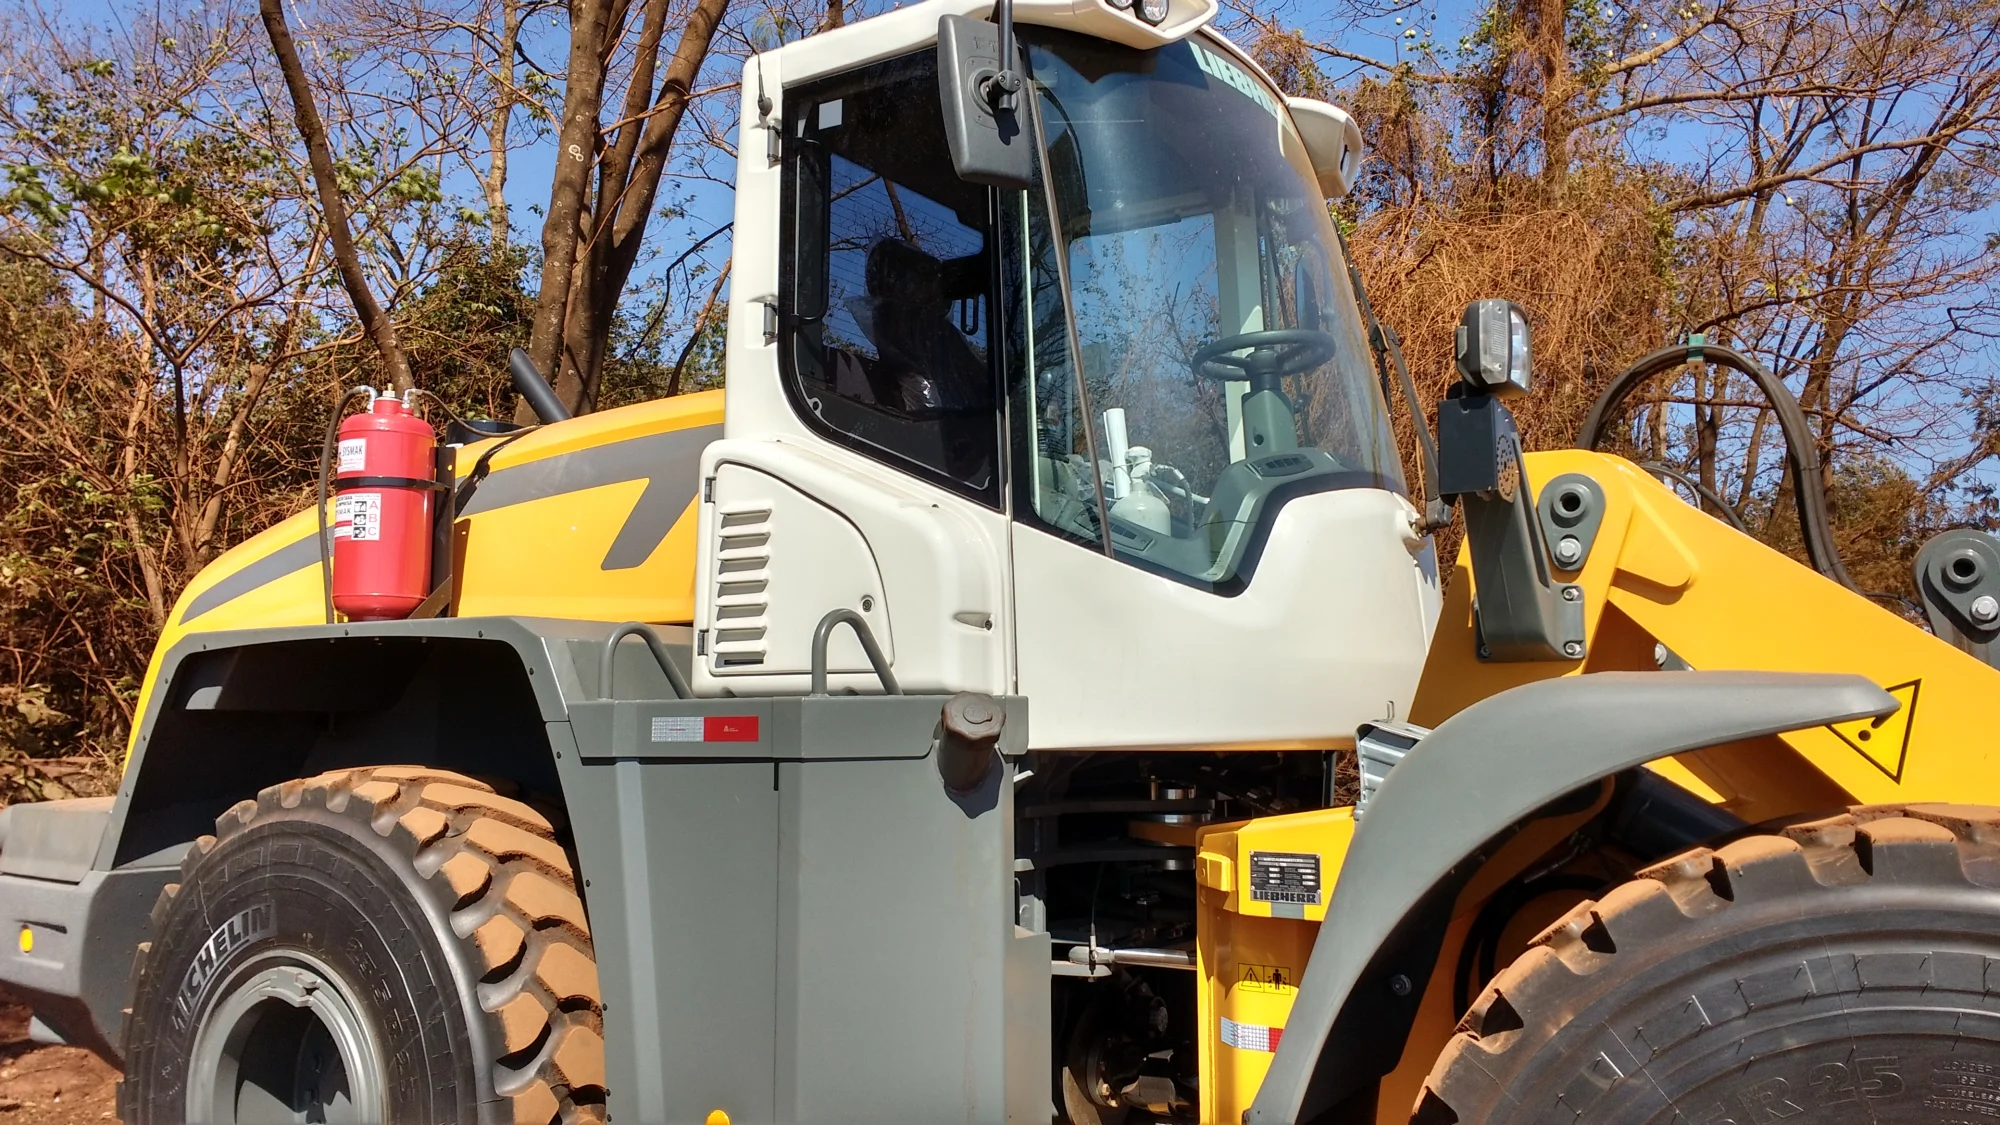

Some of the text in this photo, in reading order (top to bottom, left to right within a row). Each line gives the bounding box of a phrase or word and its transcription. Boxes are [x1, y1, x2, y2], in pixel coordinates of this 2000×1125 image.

[369, 501, 379, 509] A
[369, 514, 377, 522] B
[368, 527, 377, 535] C
[1253, 891, 1316, 903] LIEBHERR
[171, 904, 272, 1037] MICHELIN
[1944, 1061, 1993, 1073] LOADER
[1808, 1056, 1905, 1106] 25
